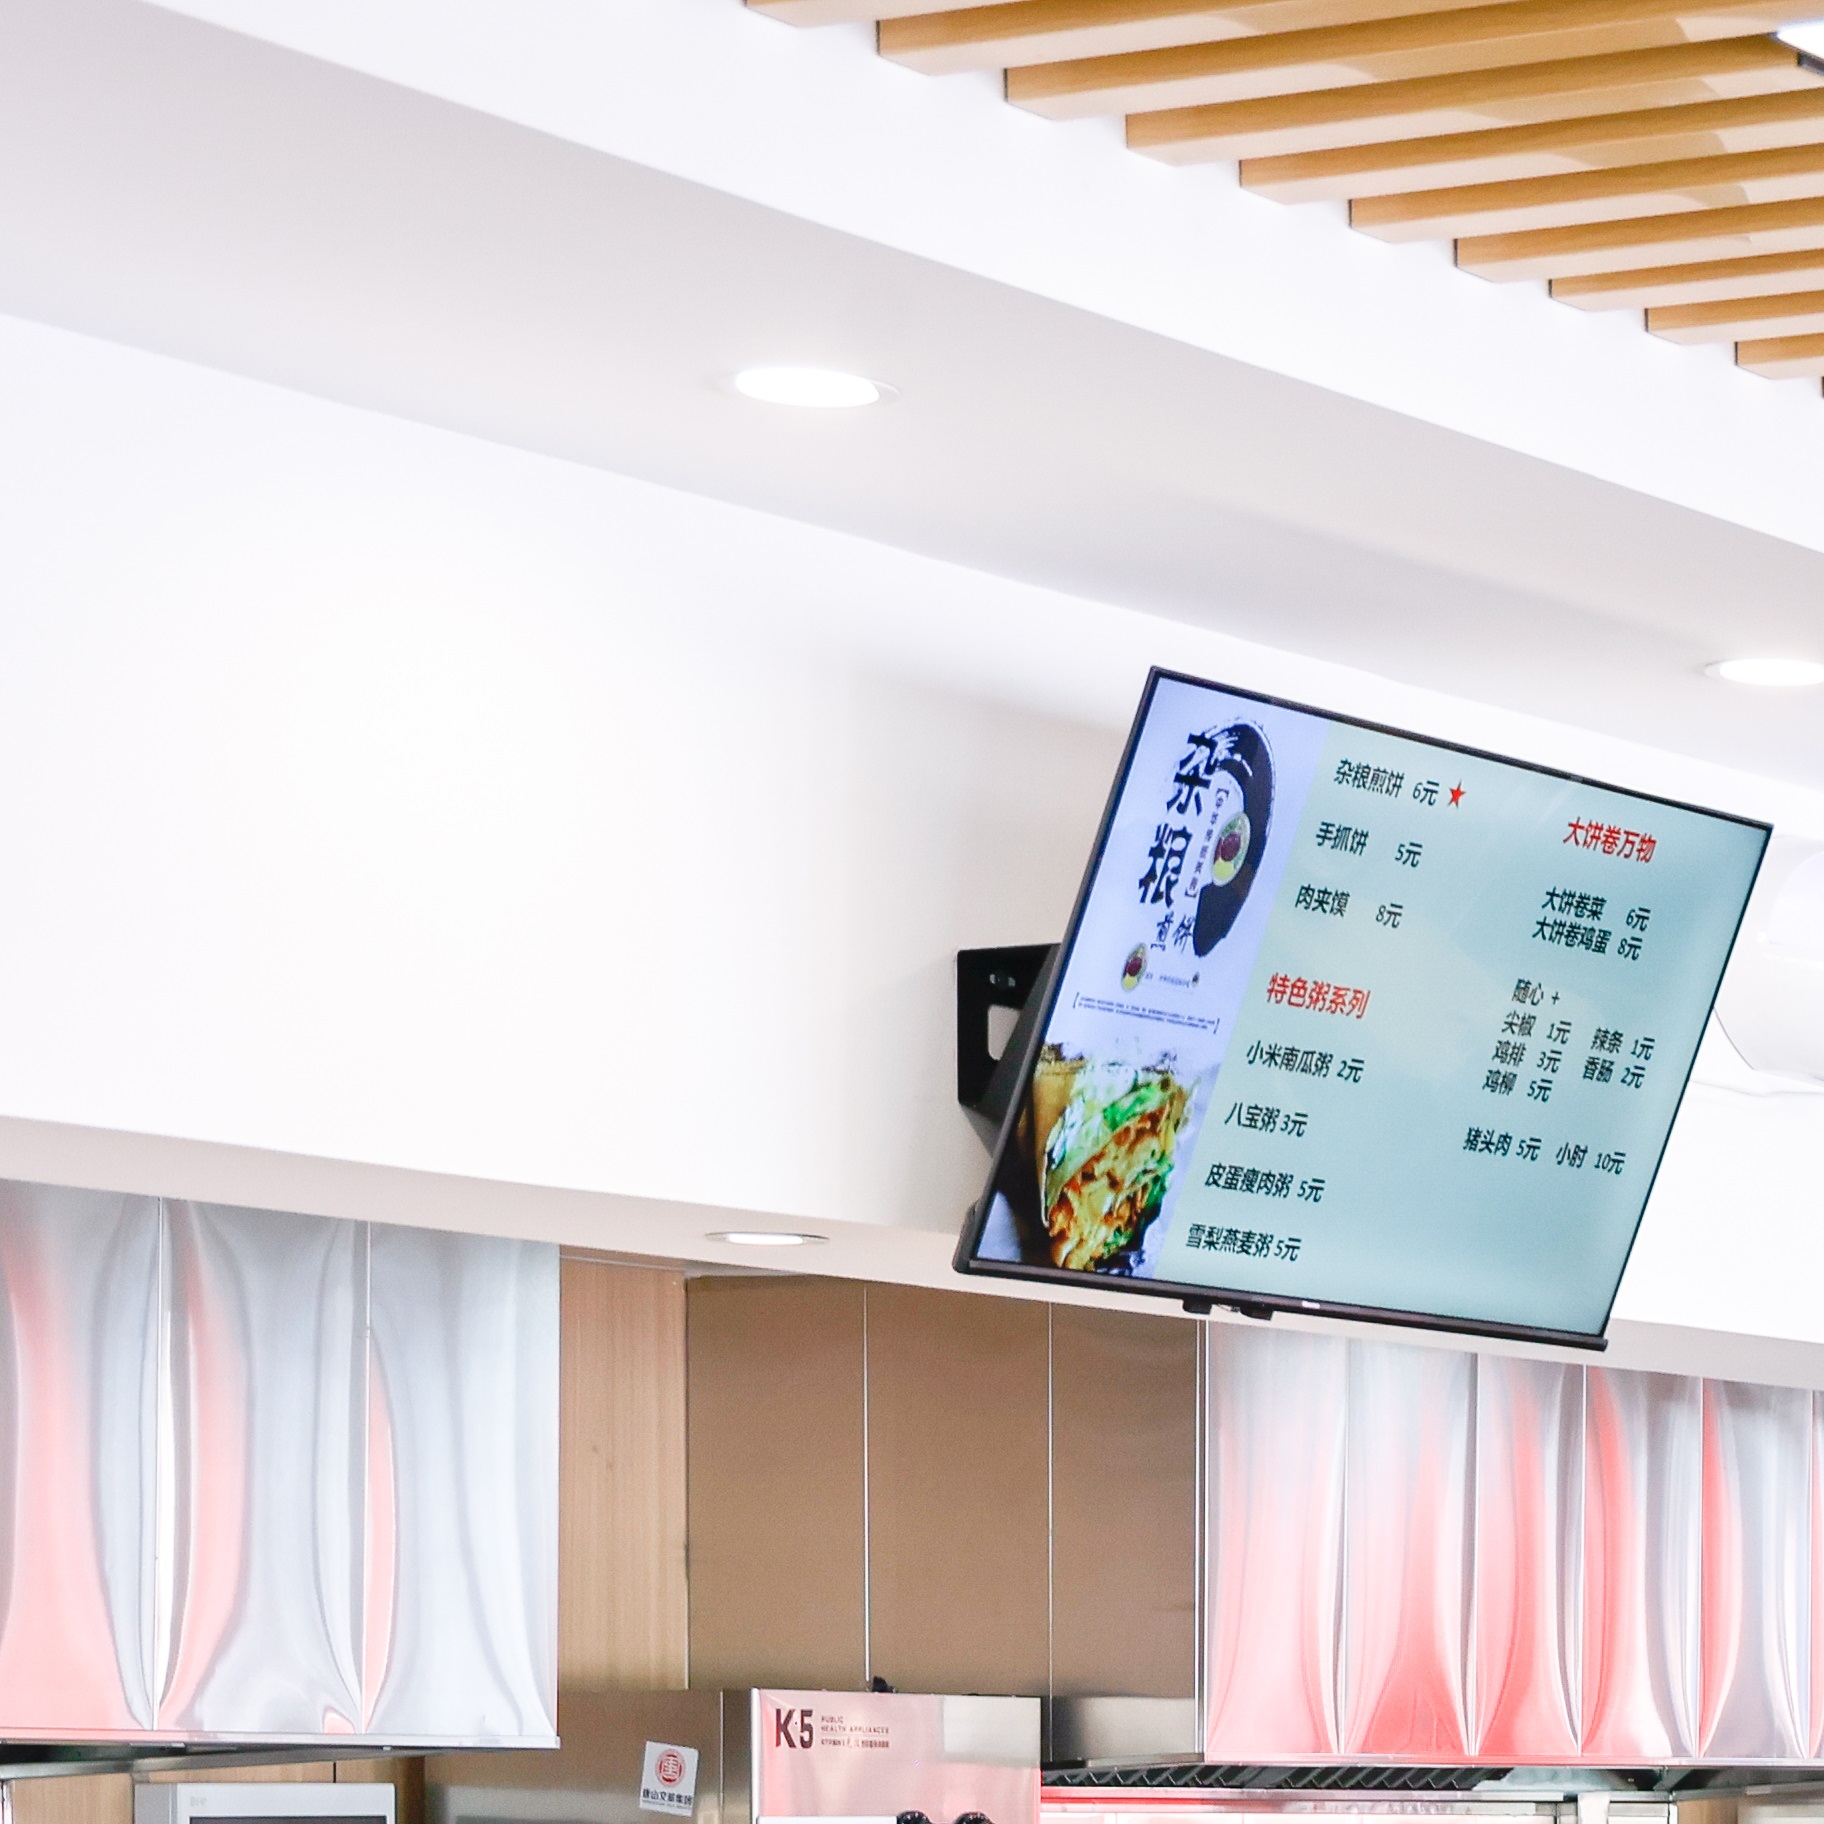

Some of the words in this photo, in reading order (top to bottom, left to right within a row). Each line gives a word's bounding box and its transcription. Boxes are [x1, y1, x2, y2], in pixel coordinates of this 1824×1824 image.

[1333, 758, 1405, 799] 杂粮煎饼
[1412, 780, 1440, 806] 6元
[1315, 820, 1369, 856] 手抓饼
[1394, 841, 1423, 868] 5元
[1562, 816, 1658, 864] 大饼卷万物
[1294, 884, 1350, 917] 肉夹馍
[1375, 902, 1403, 929] 8元
[1541, 885, 1607, 921] 大饼卷菜
[1625, 906, 1651, 932] 6元
[1532, 915, 1612, 954] 大饼卷鸡蛋
[1617, 936, 1643, 961] 8元
[1266, 972, 1371, 1020] 特色粥系列
[1501, 1010, 1537, 1038] 尖椒
[1546, 1020, 1572, 1045] 1元
[1590, 1026, 1624, 1054] 辣条
[1630, 1036, 1656, 1061] 1元
[1246, 1039, 1333, 1079] 小米南瓜粥
[1336, 1057, 1365, 1083] 2元
[1491, 1039, 1527, 1068] 鸡排
[1536, 1049, 1563, 1074] 3元
[1582, 1056, 1615, 1084] 香肠
[1620, 1065, 1646, 1089] 2元
[1482, 1068, 1518, 1096] 鸡柳
[1527, 1078, 1553, 1103] 5元
[1224, 1101, 1281, 1134] 八宝粥
[1280, 1112, 1309, 1137] 3元
[1462, 1126, 1513, 1157] 猪头肉
[1516, 1137, 1542, 1162] 5元
[1556, 1142, 1588, 1169] 小肘
[1594, 1151, 1626, 1175] 10元
[1204, 1162, 1294, 1199] 皮蛋瘦肉粥
[1297, 1177, 1326, 1203] 5元
[1185, 1222, 1274, 1258] 雪梨燕麦粥
[1273, 1236, 1302, 1262] 5元
